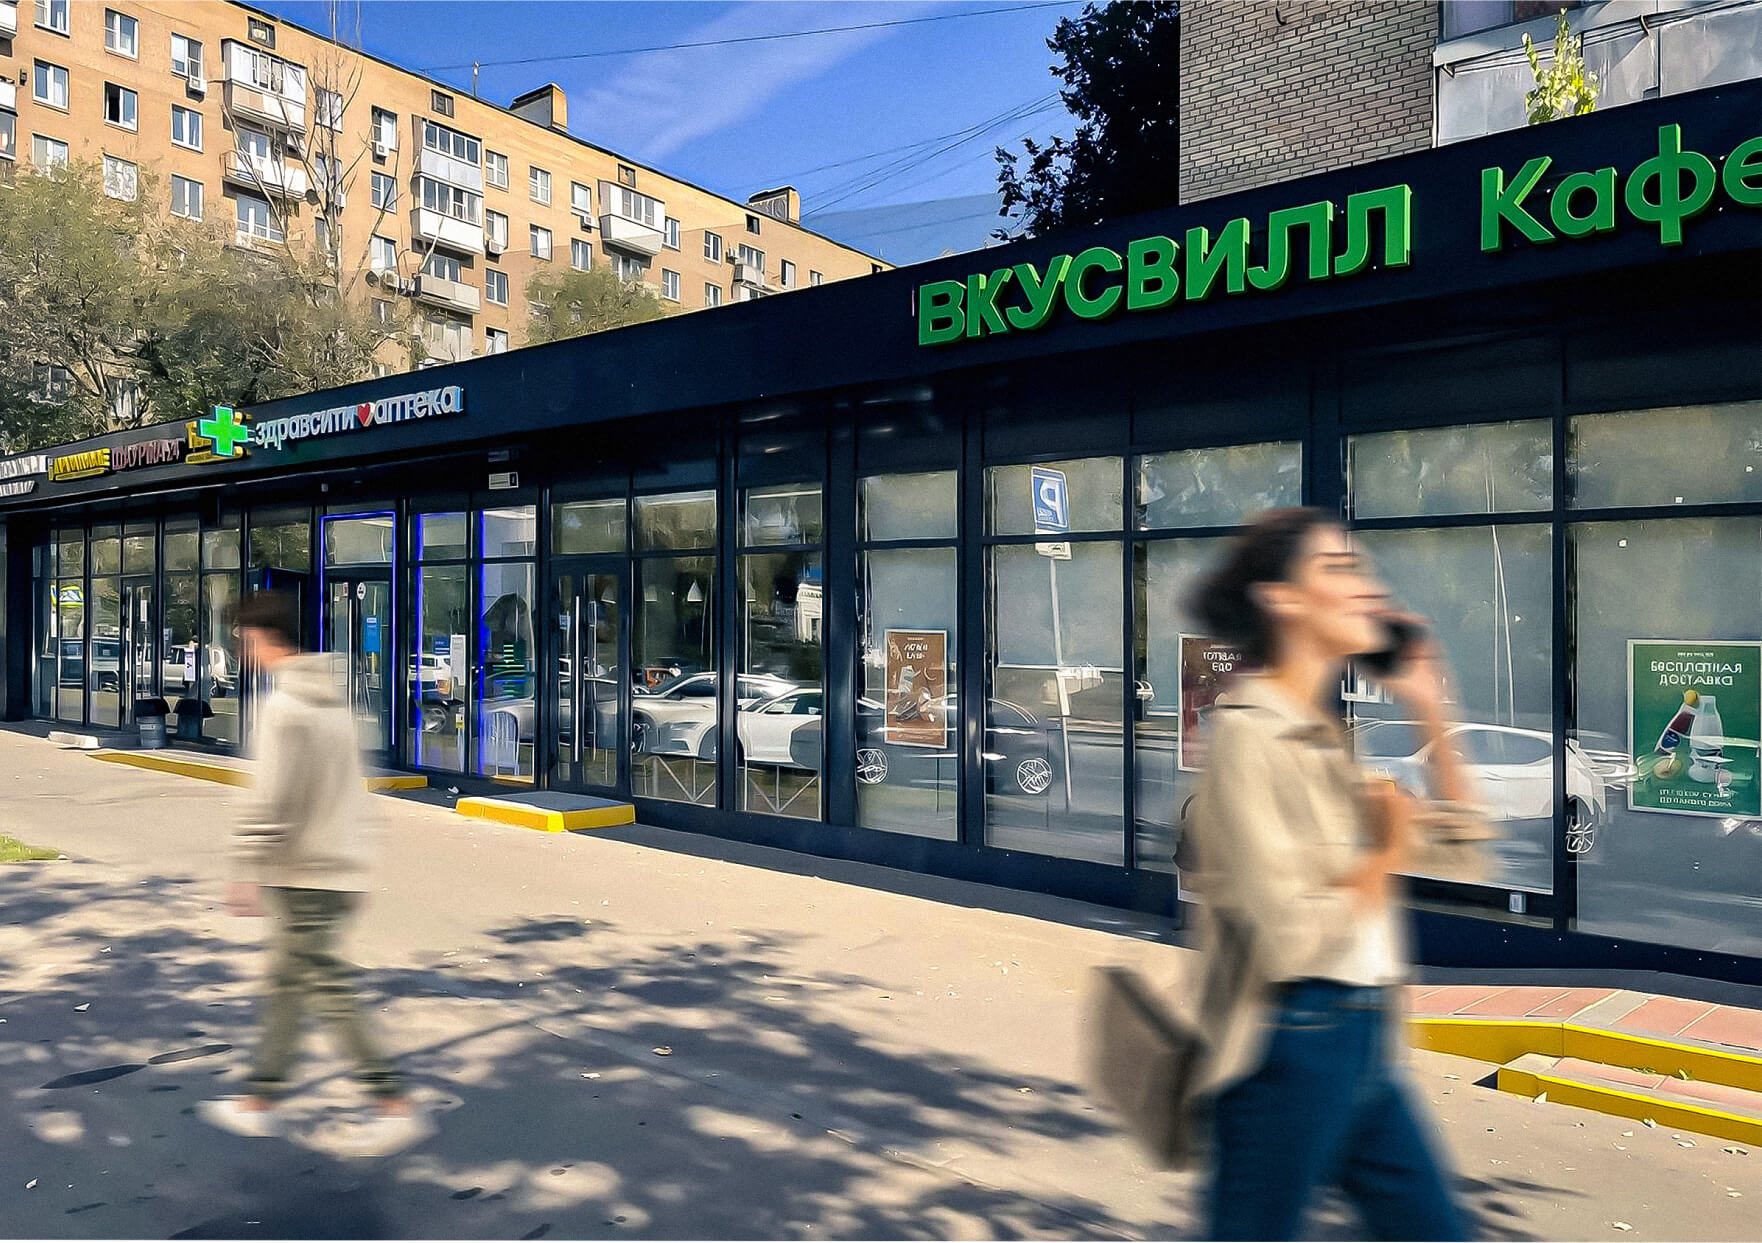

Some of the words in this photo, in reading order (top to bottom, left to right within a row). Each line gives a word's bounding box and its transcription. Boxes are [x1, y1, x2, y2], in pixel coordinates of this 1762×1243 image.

[918, 184, 1412, 346] ВКУСВИЛЛ
[1481, 123, 1762, 253] Кафе
[254, 404, 360, 450] здравсити
[374, 385, 464, 425] аптека
